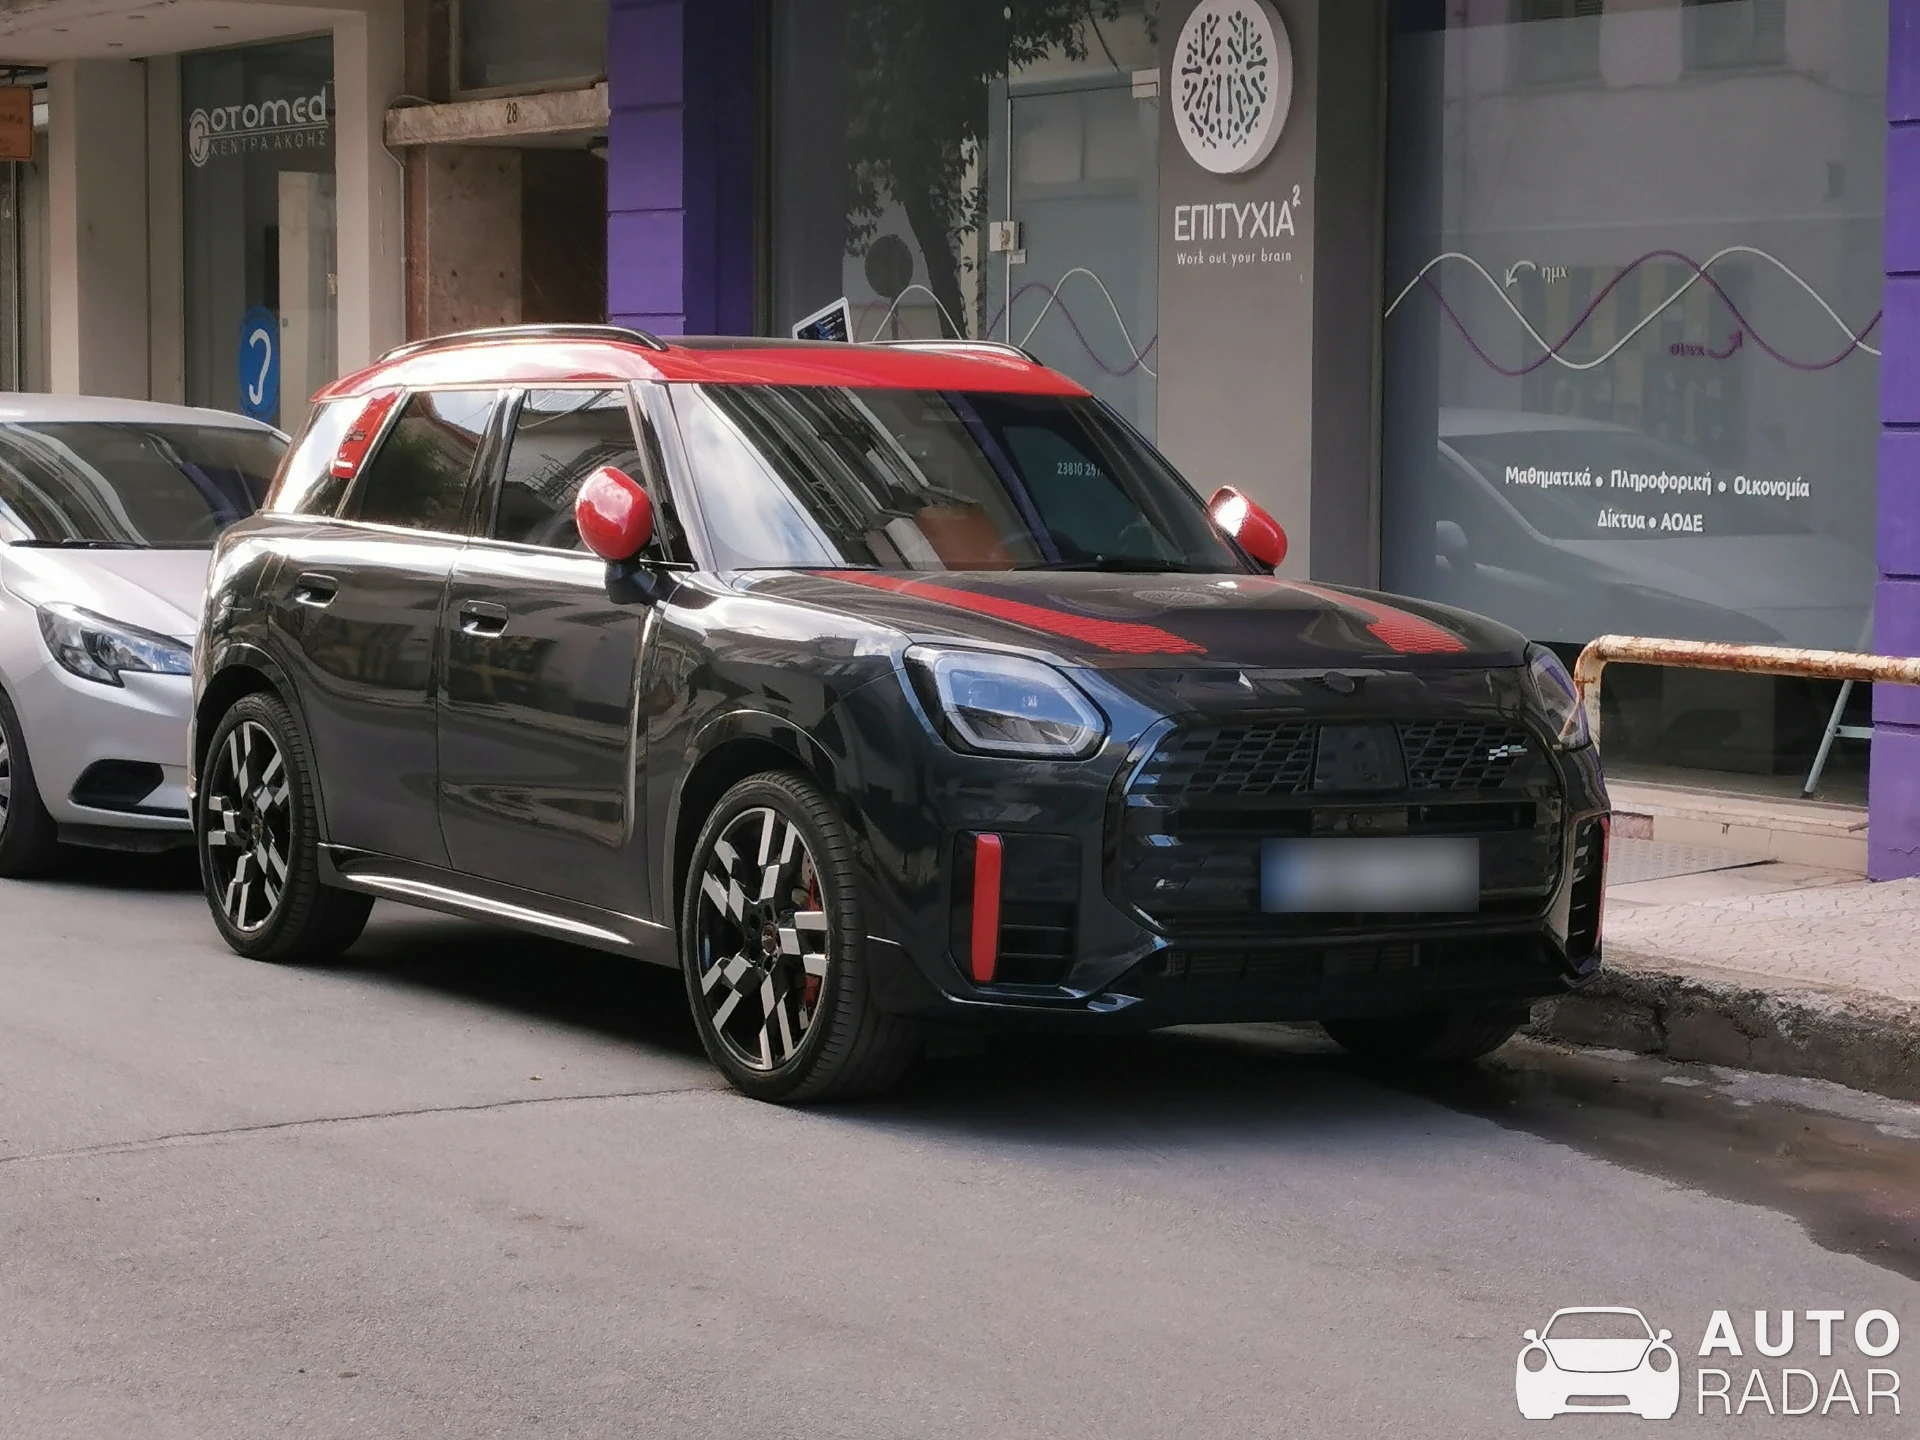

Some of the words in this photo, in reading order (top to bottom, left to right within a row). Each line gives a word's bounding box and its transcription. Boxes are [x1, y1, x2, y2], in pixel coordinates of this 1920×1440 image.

[505, 102, 518, 124] 28
[274, 130, 327, 150] ΑΚΟΗΣ
[1177, 249, 1204, 266] Work
[1208, 252, 1227, 264] out
[1231, 252, 1256, 268] your
[1261, 247, 1292, 263] brain
[1057, 462, 1083, 476] 23810
[1505, 466, 1592, 489] Μαθηματικά
[1610, 469, 1712, 496] Πληροφορική
[1734, 475, 1810, 501] Οικονομία
[1597, 508, 1646, 529] Δίκτυα
[1660, 512, 1704, 533] ΑΟΔΕ
